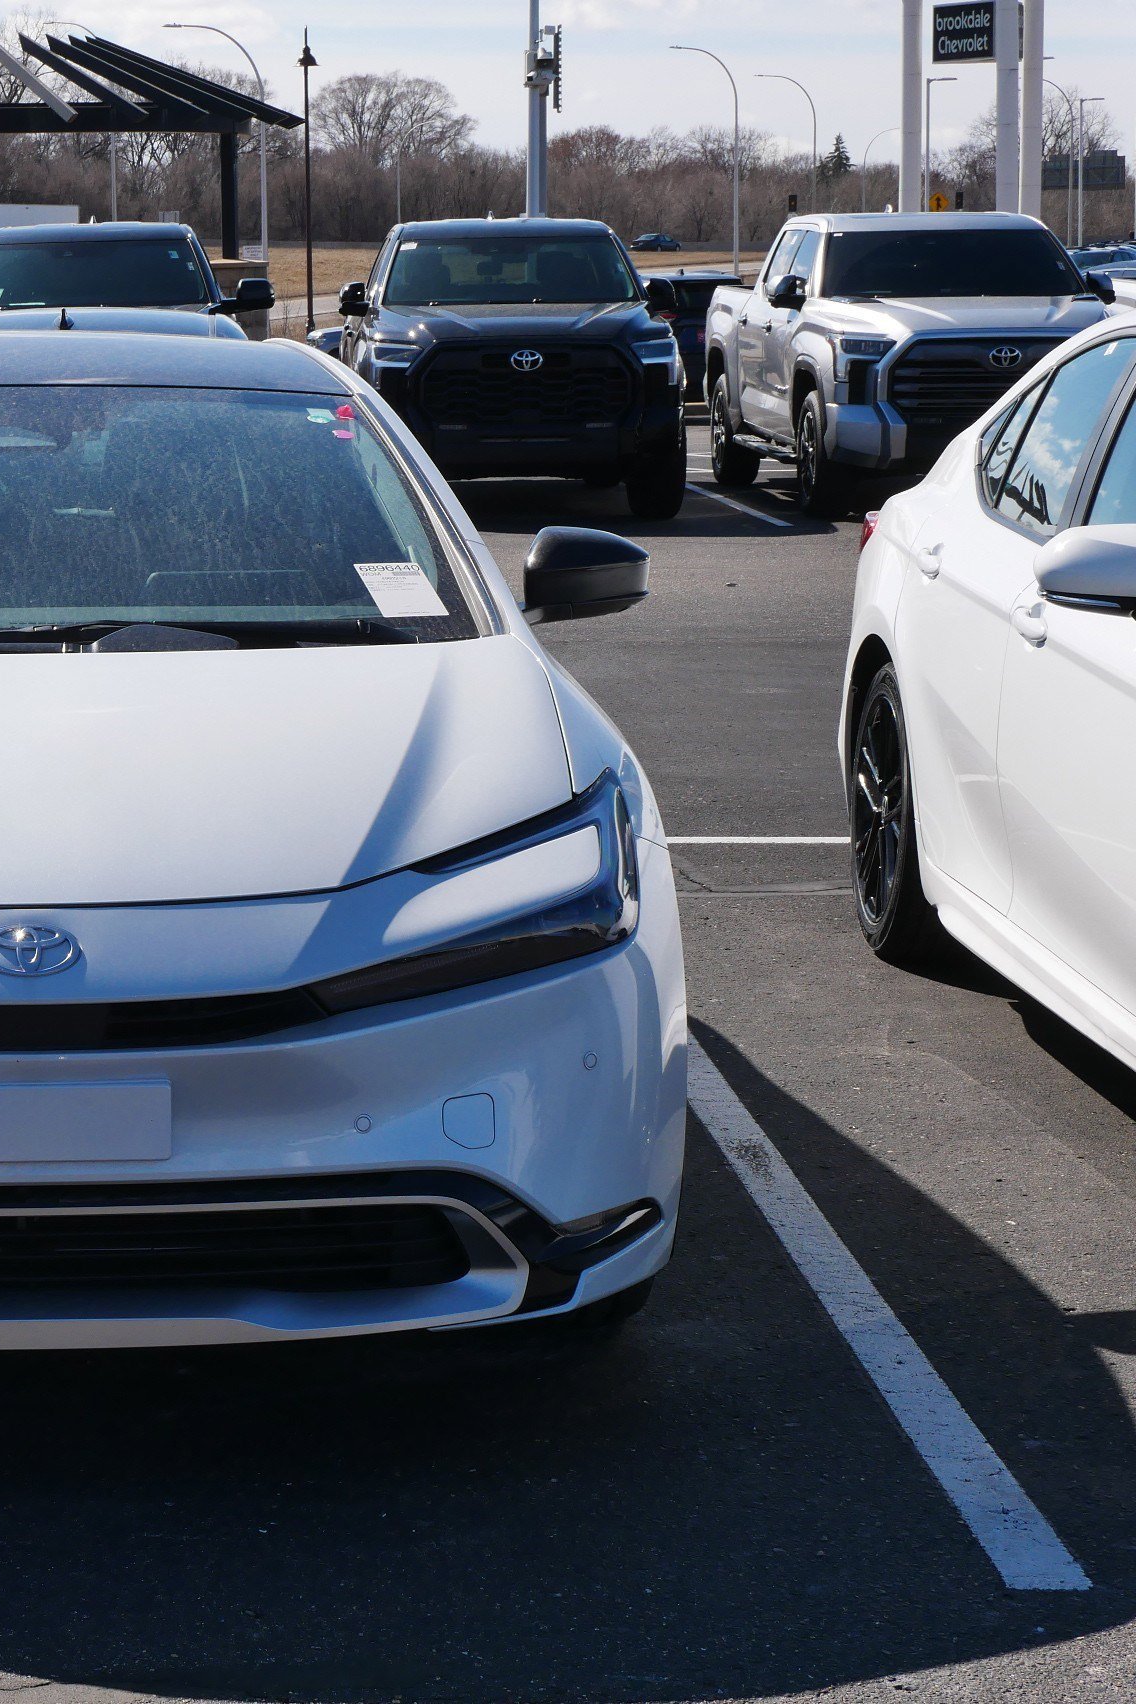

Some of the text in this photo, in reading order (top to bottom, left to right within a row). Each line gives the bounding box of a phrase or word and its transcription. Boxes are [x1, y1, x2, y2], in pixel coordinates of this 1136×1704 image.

[936, 10, 991, 31] brookdale
[938, 33, 989, 54] Chevrolet
[359, 564, 420, 572] 6896440
